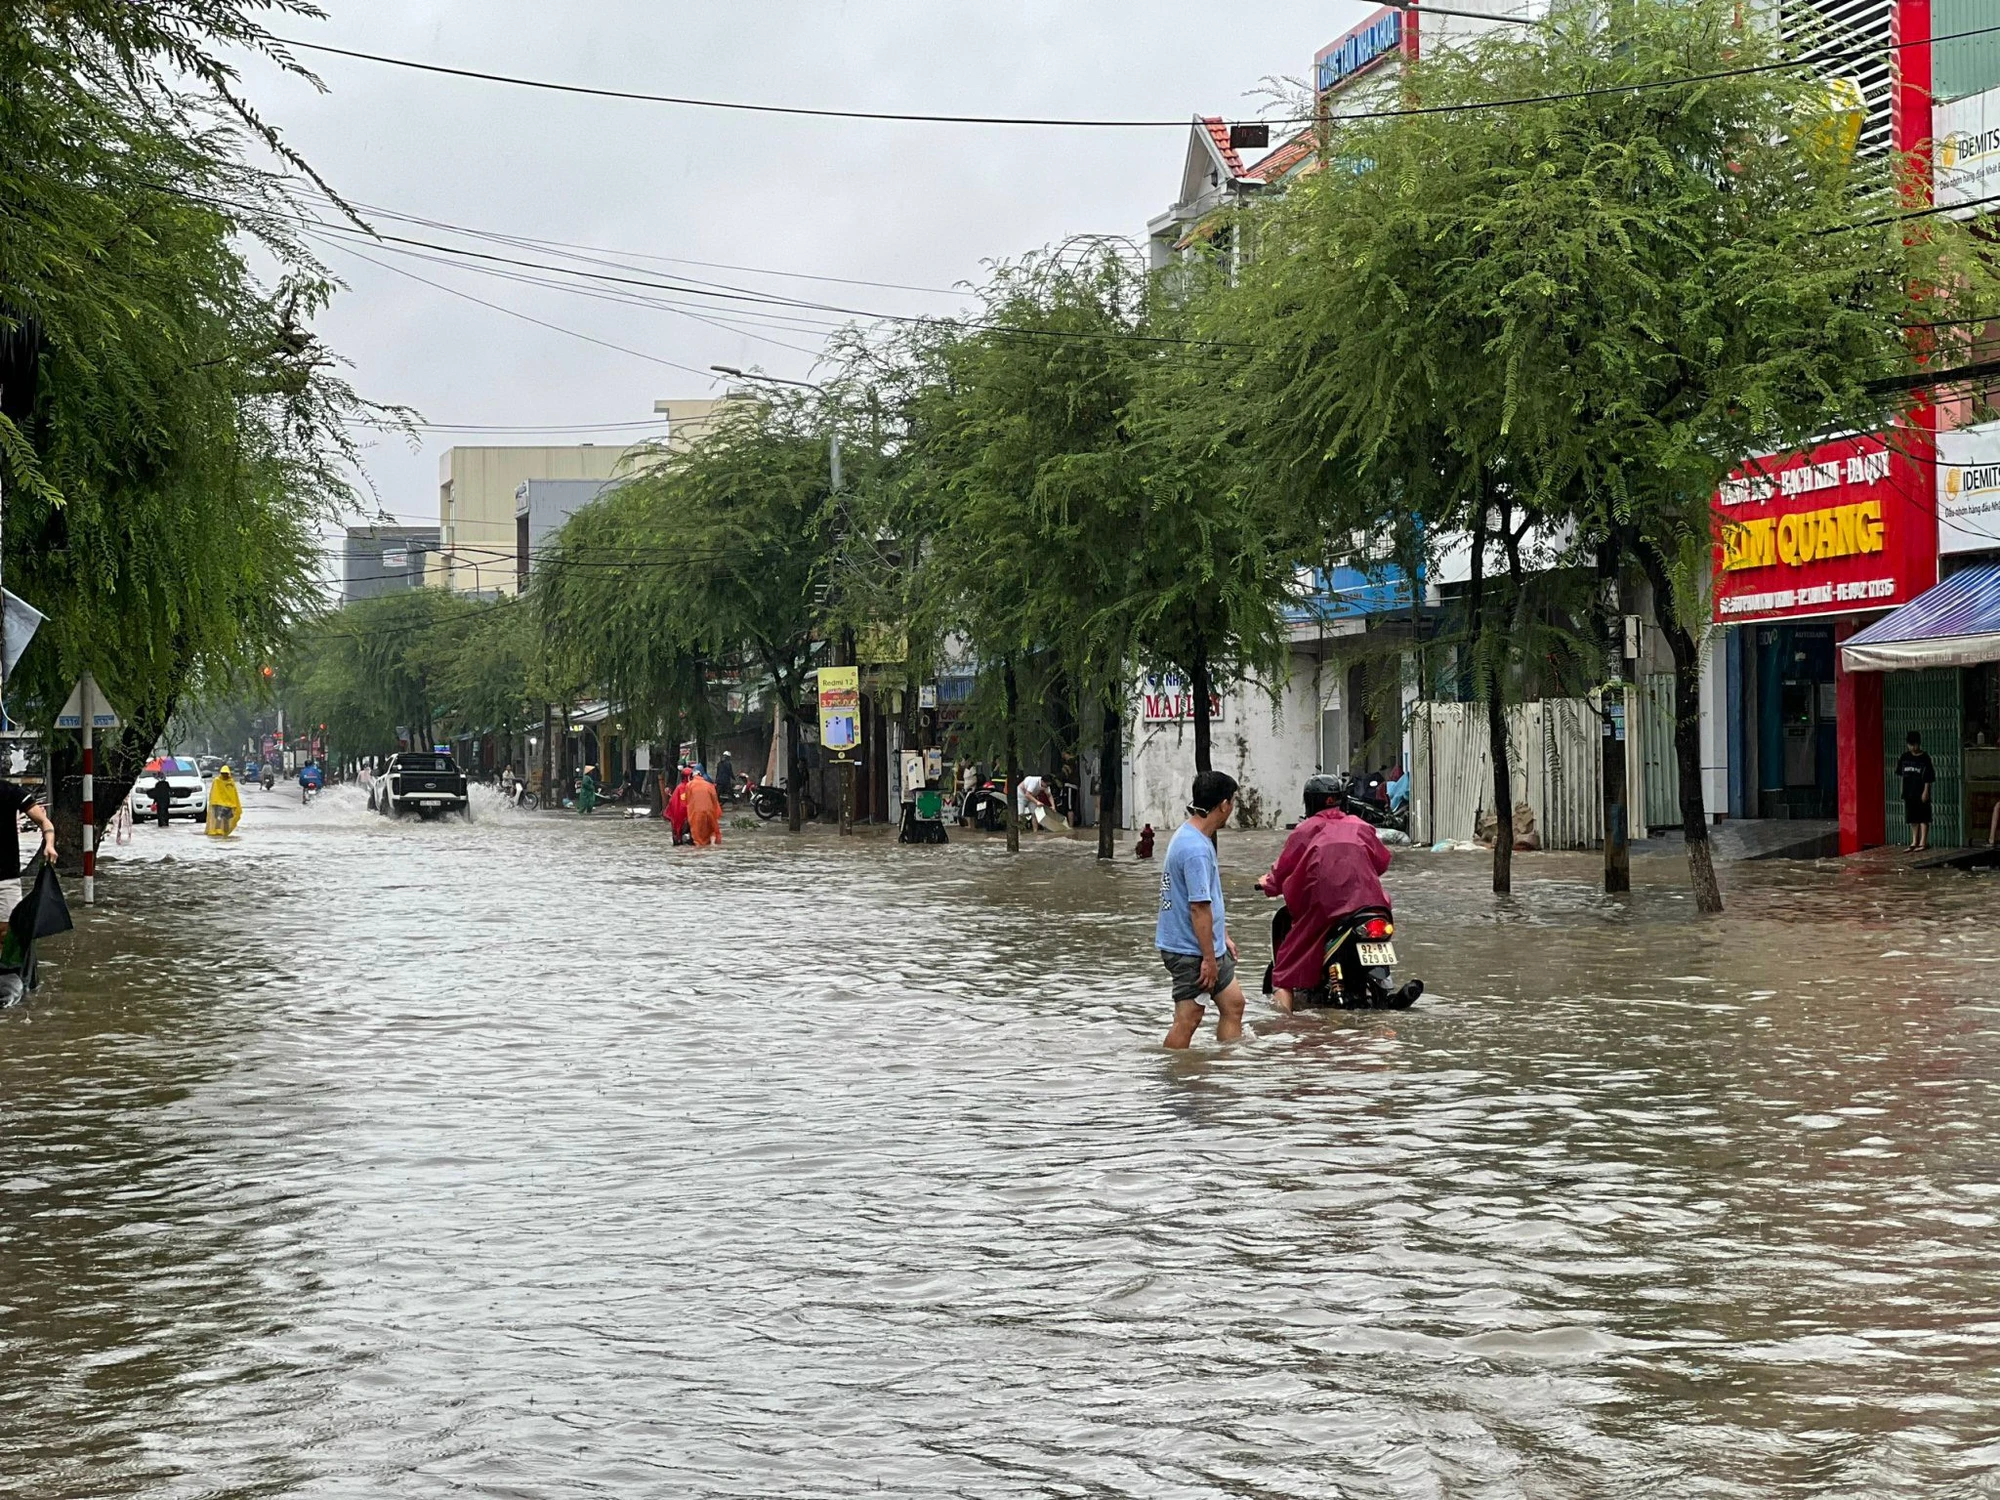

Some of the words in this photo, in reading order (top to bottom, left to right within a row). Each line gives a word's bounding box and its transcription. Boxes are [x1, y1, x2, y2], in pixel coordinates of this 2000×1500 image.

[1375, 12, 1395, 54] KHOA
[1722, 517, 1777, 571] KIM
[1778, 500, 1885, 567] QUANG
